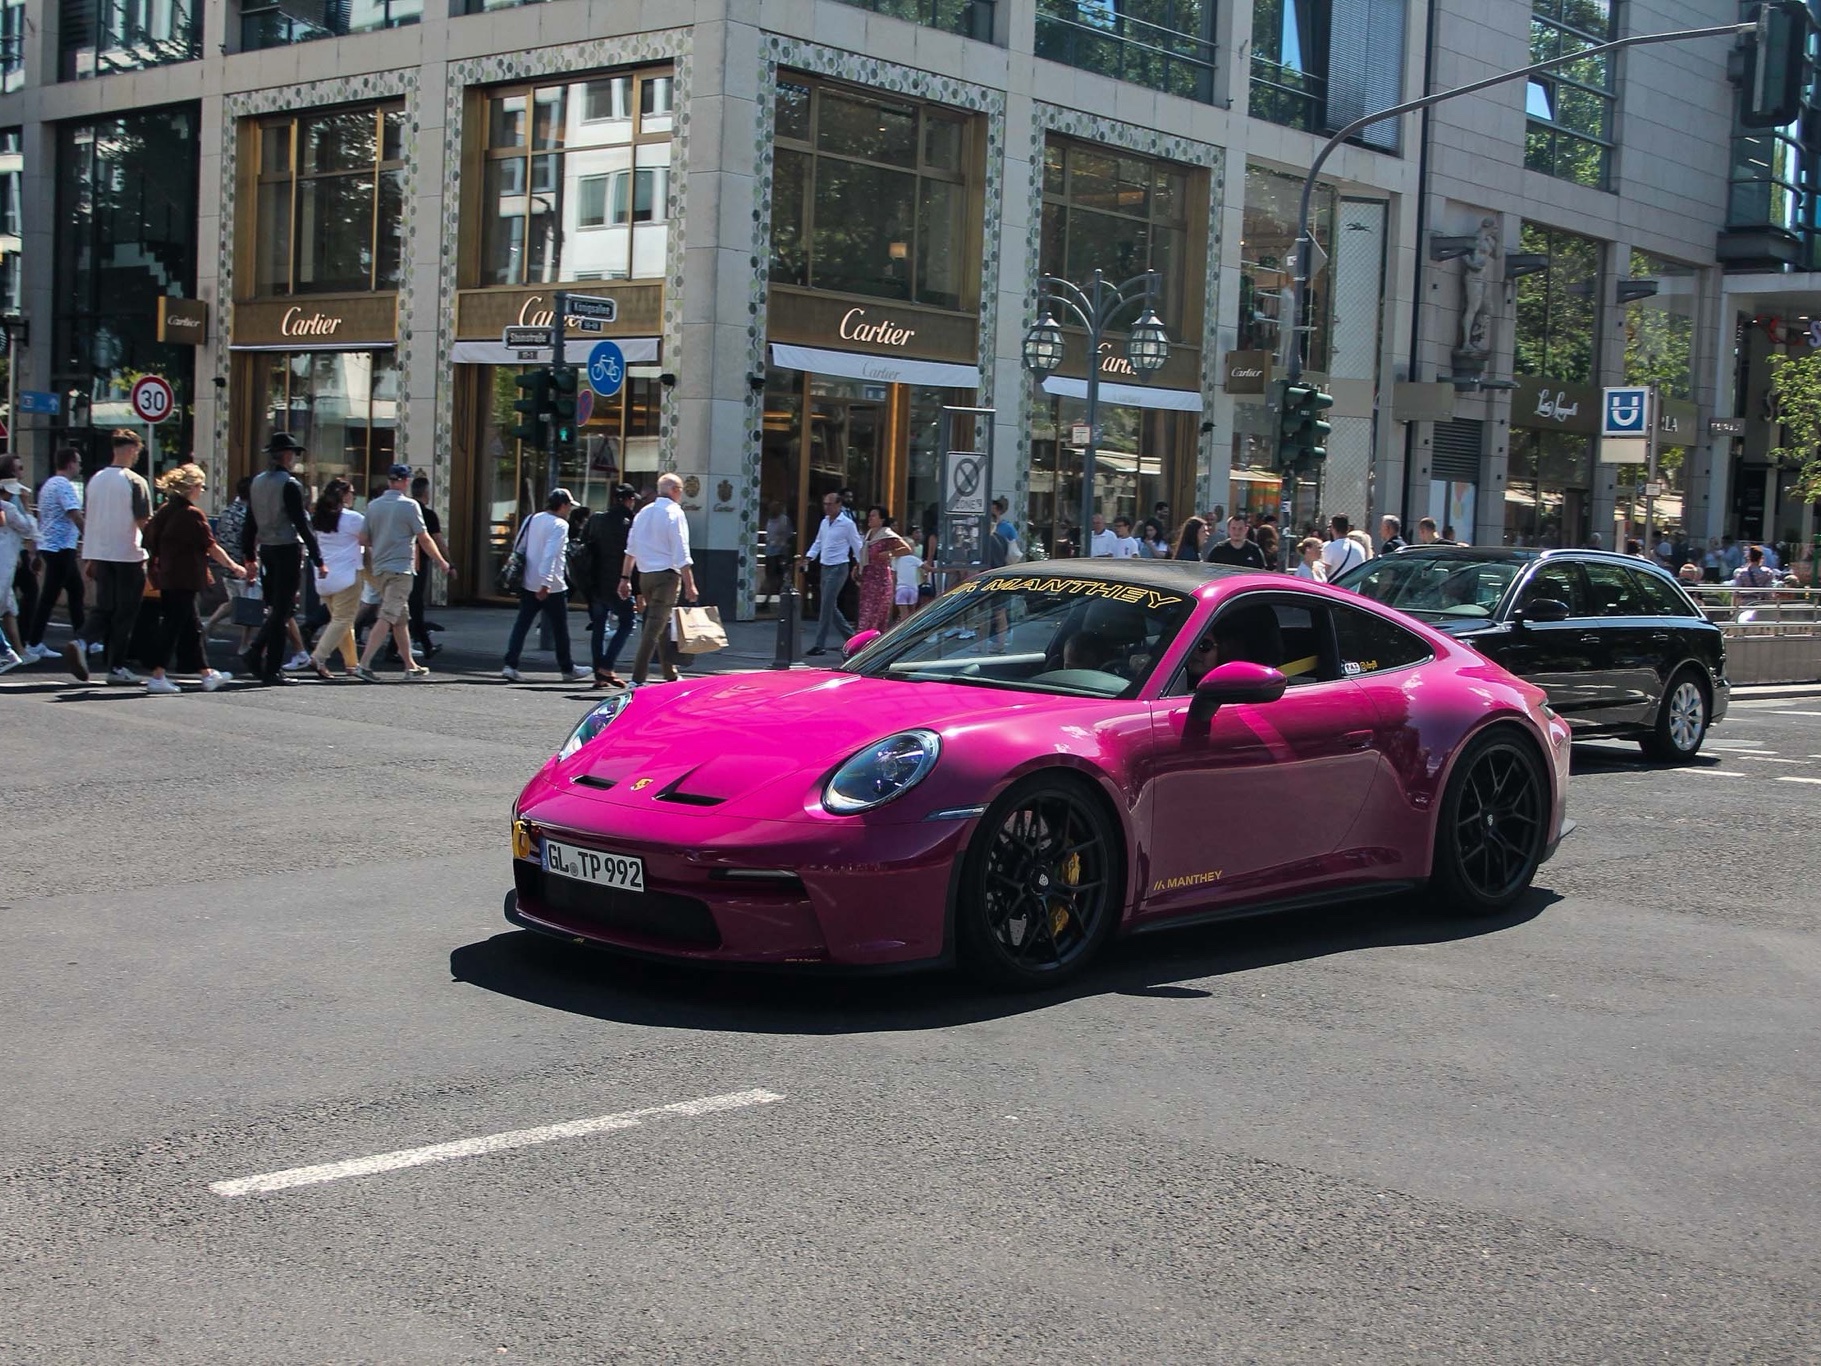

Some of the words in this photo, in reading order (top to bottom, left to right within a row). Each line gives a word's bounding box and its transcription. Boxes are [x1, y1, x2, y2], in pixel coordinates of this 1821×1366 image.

[167, 314, 202, 328] Cartier
[281, 306, 342, 336] Cartier
[839, 307, 916, 346] Cartier
[862, 360, 901, 380] Cartier
[1230, 366, 1263, 378] Cartier
[140, 389, 165, 412] 30
[981, 578, 1182, 609] MANTHEY
[548, 843, 569, 873] GL
[578, 851, 601, 880] TP
[604, 857, 642, 888] 992
[1167, 870, 1222, 889] MANTHEY
